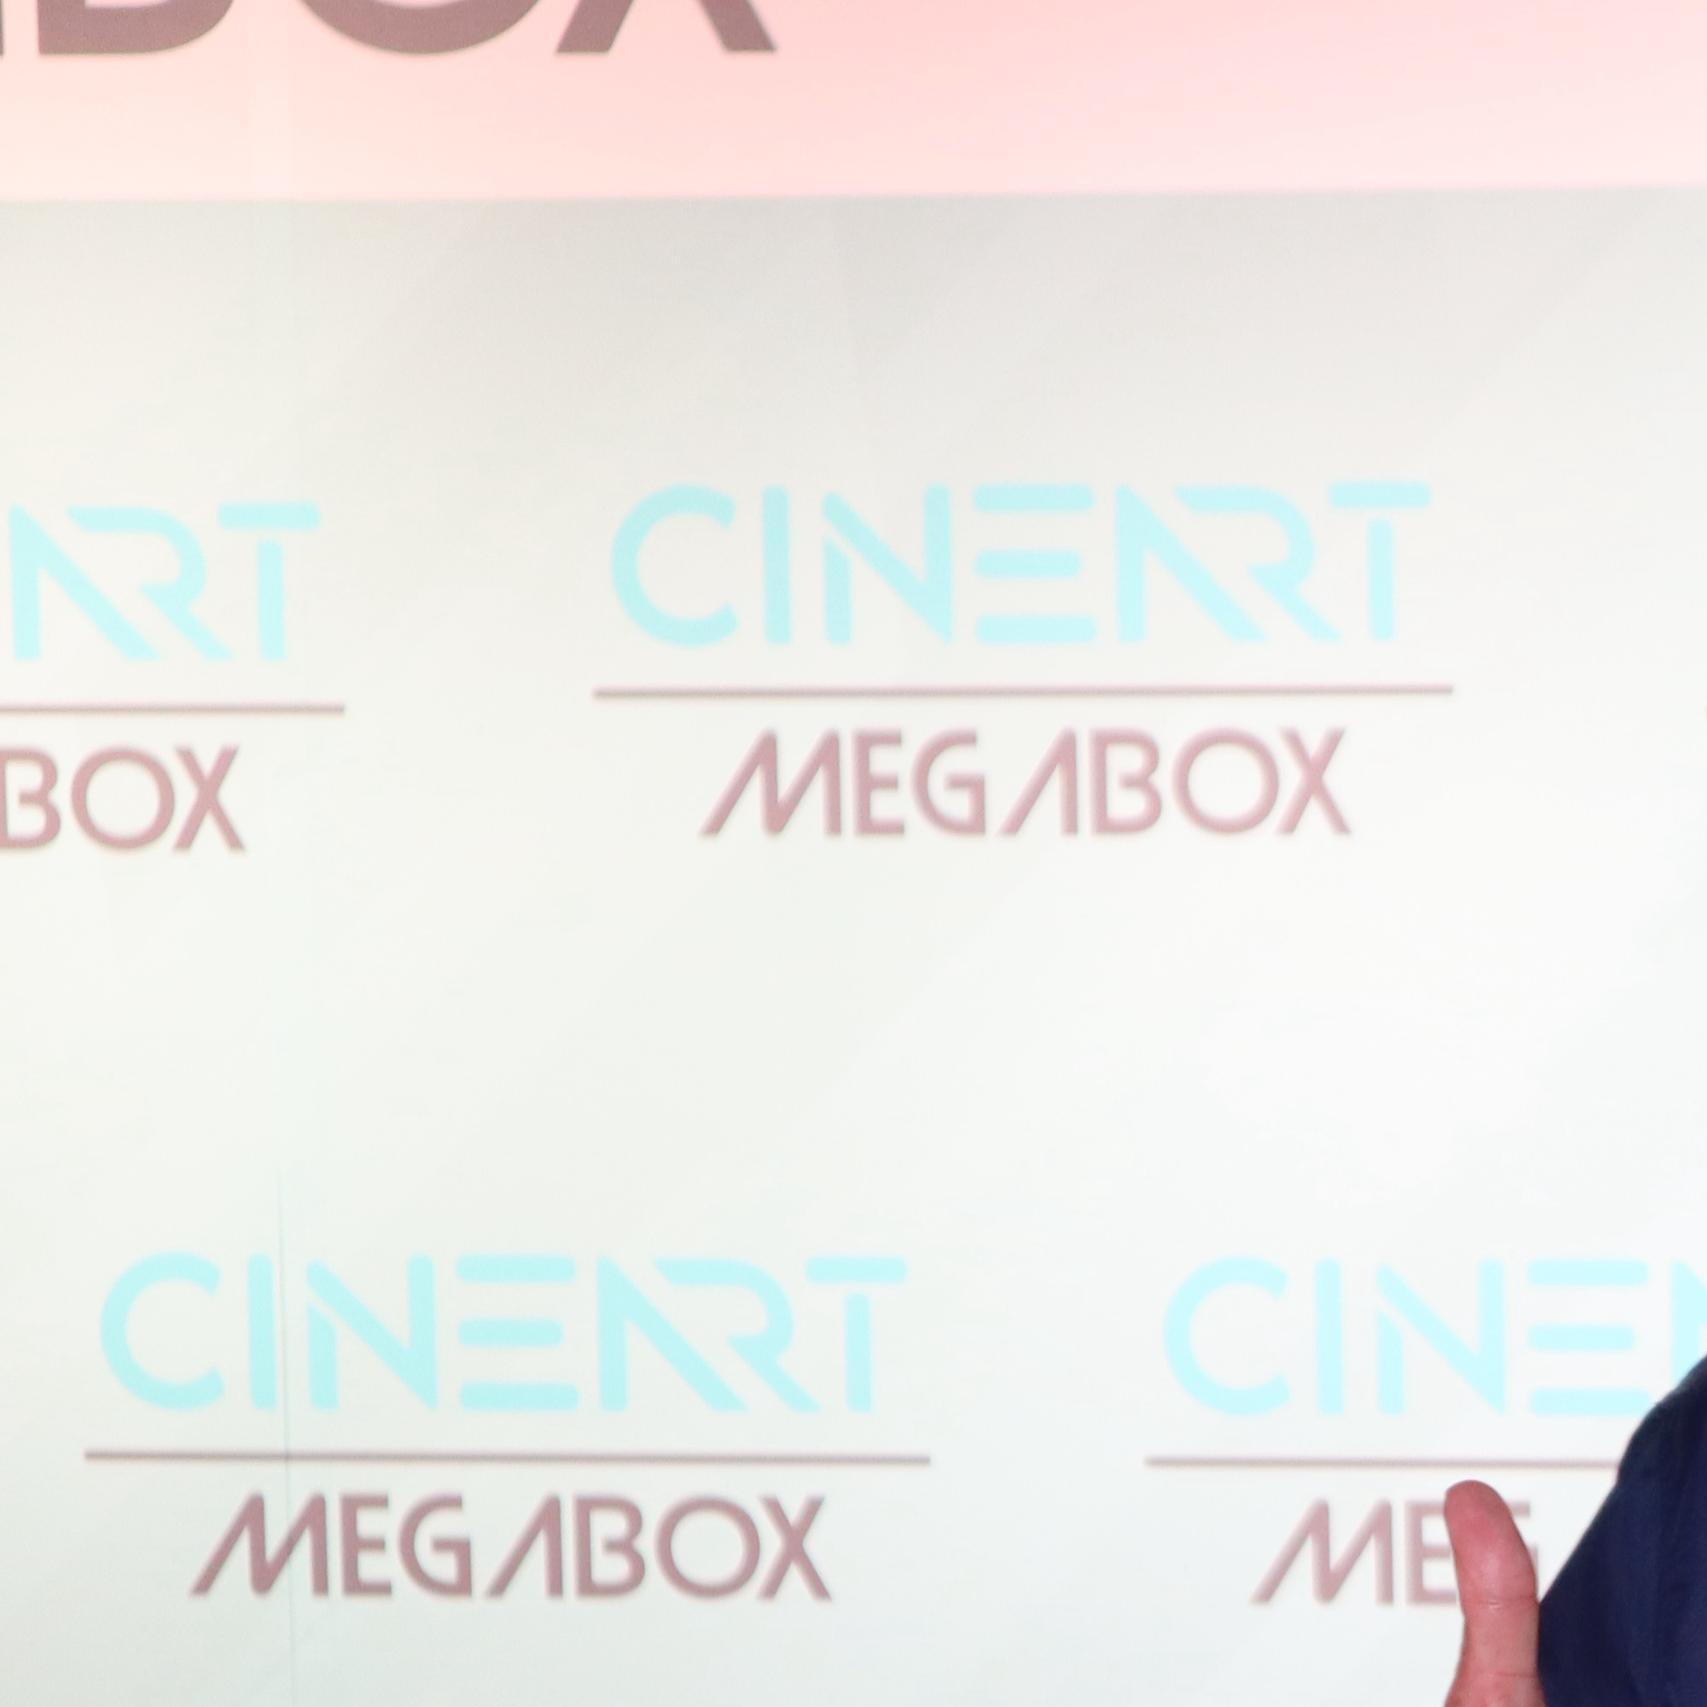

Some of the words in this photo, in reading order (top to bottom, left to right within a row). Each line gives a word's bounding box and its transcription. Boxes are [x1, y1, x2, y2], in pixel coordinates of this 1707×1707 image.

[610, 481, 1433, 648] CINEART
[698, 728, 1352, 836] MEGABOX
[99, 1251, 909, 1412] CINEART
[189, 1491, 834, 1602] MEGABOX
[1250, 1498, 1540, 1606] ME
